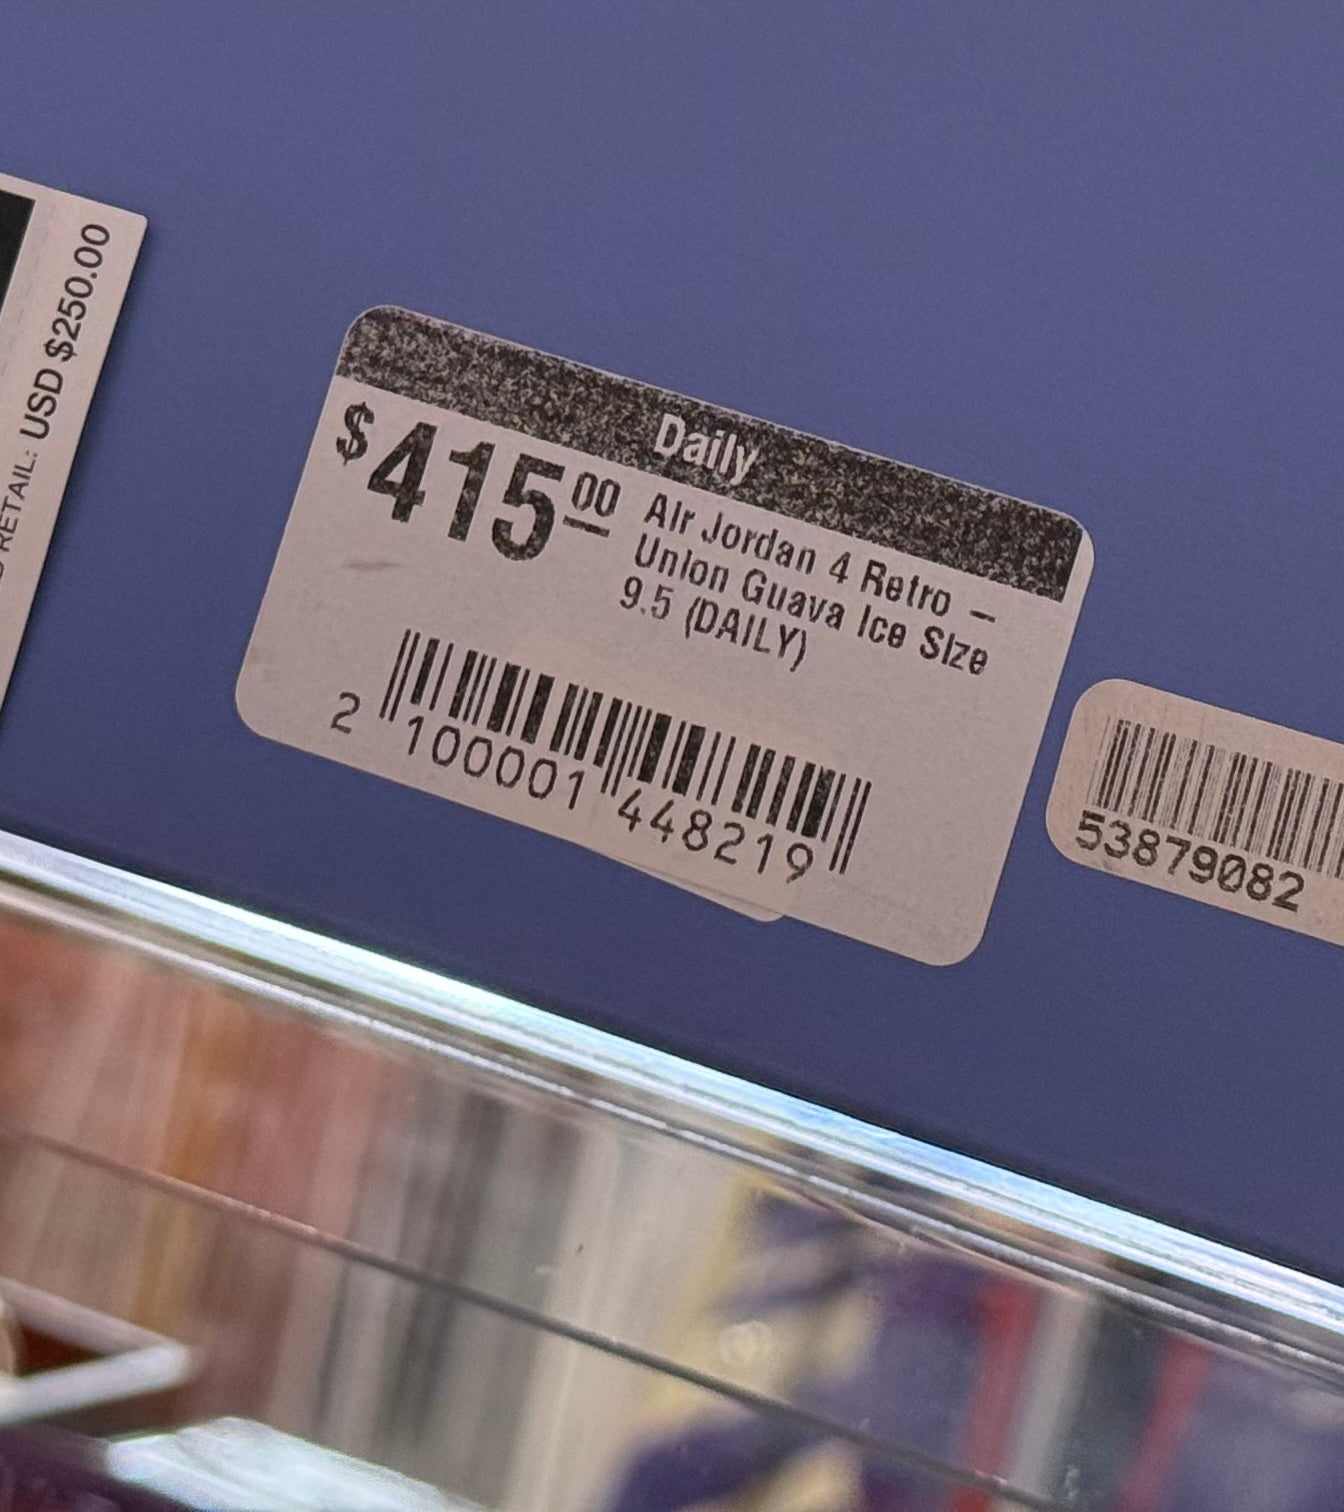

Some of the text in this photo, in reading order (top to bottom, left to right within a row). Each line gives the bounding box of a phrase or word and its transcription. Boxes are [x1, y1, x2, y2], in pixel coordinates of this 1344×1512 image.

[19, 368, 64, 439] USD
[43, 223, 110, 362] $250.00
[653, 413, 759, 486] Daily
[634, 532, 988, 675] Union Guava Ice Size
[644, 492, 695, 535] Air
[701, 511, 816, 575] Jordan
[829, 551, 851, 584] 4
[860, 559, 951, 617] Retro
[619, 576, 807, 672] 9.5 (DAILY)
[330, 691, 814, 883] 2 100001 448219
[1074, 808, 1305, 912] 53879082
